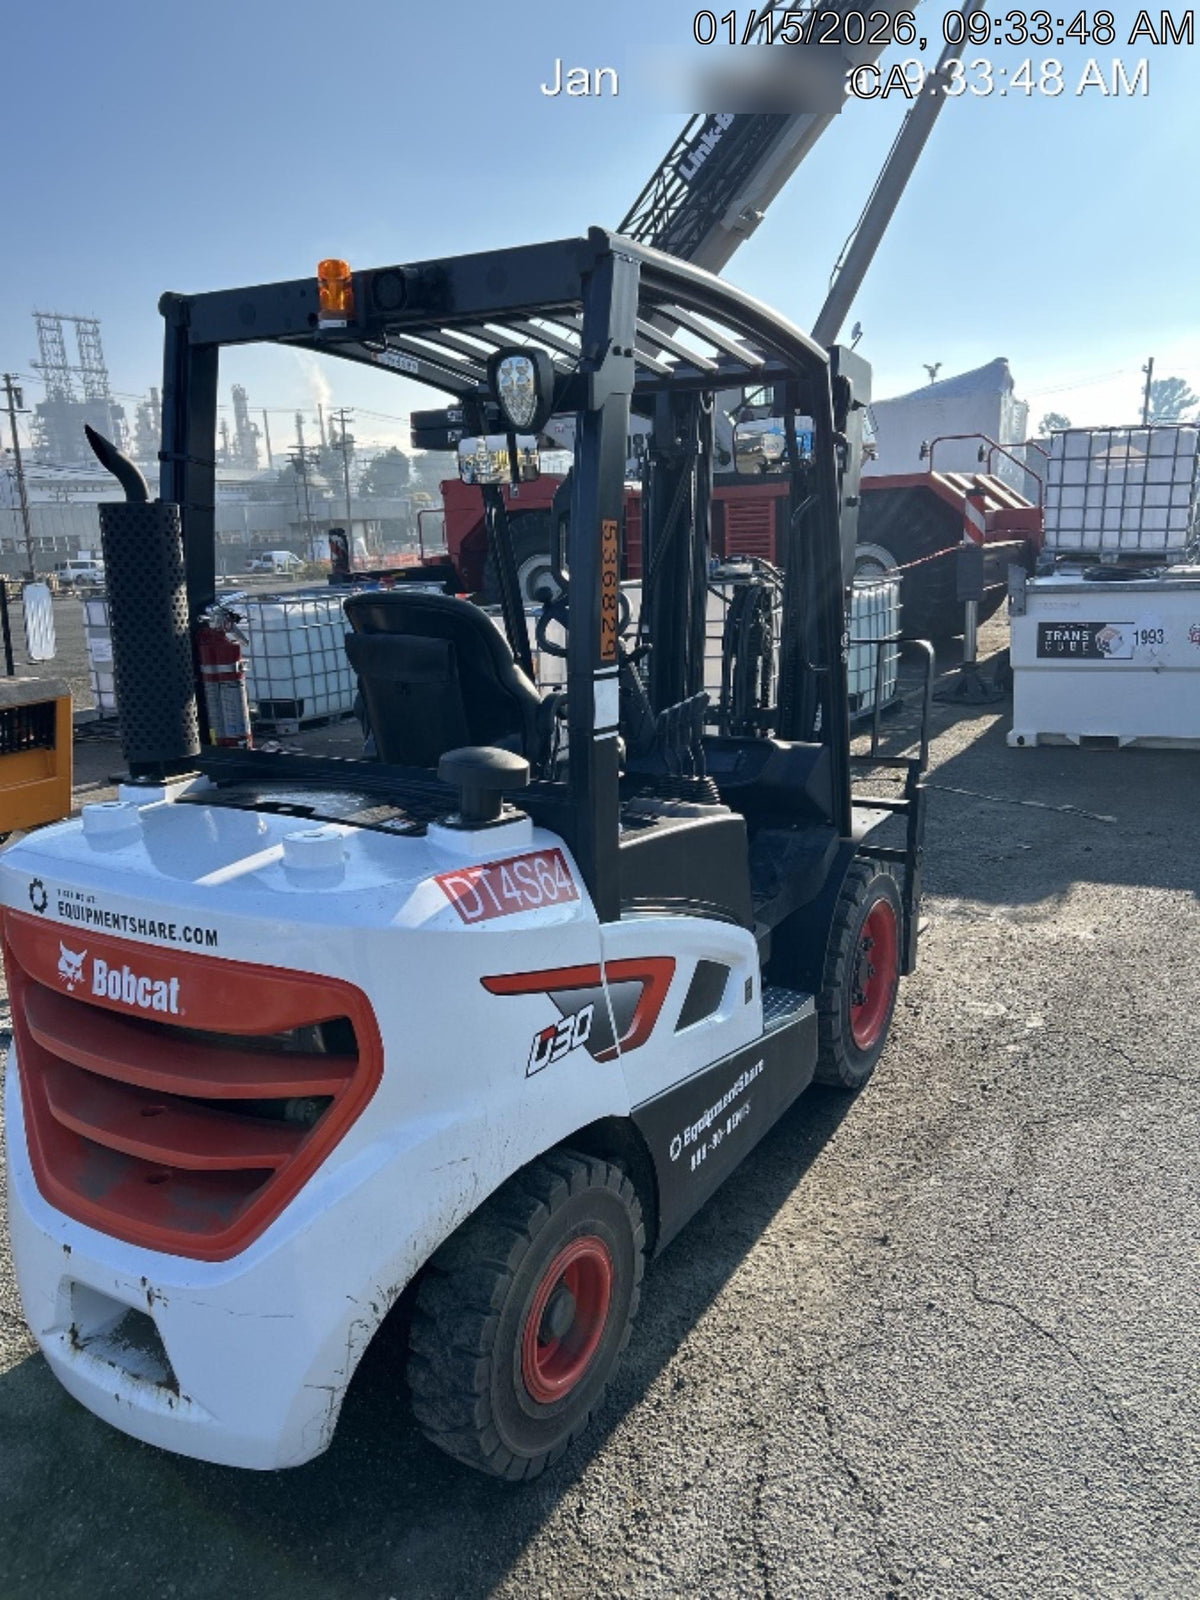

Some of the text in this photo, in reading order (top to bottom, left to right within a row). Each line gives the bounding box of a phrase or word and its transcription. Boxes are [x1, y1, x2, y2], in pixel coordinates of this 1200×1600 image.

[602, 522, 616, 658] 536829
[1044, 628, 1165, 646] TRANS 1993
[442, 854, 573, 919] DT4S64
[57, 900, 219, 947] EQUIPMENTSHARE.COM
[91, 957, 181, 1015] Bobcat
[524, 1001, 595, 1080] D30
